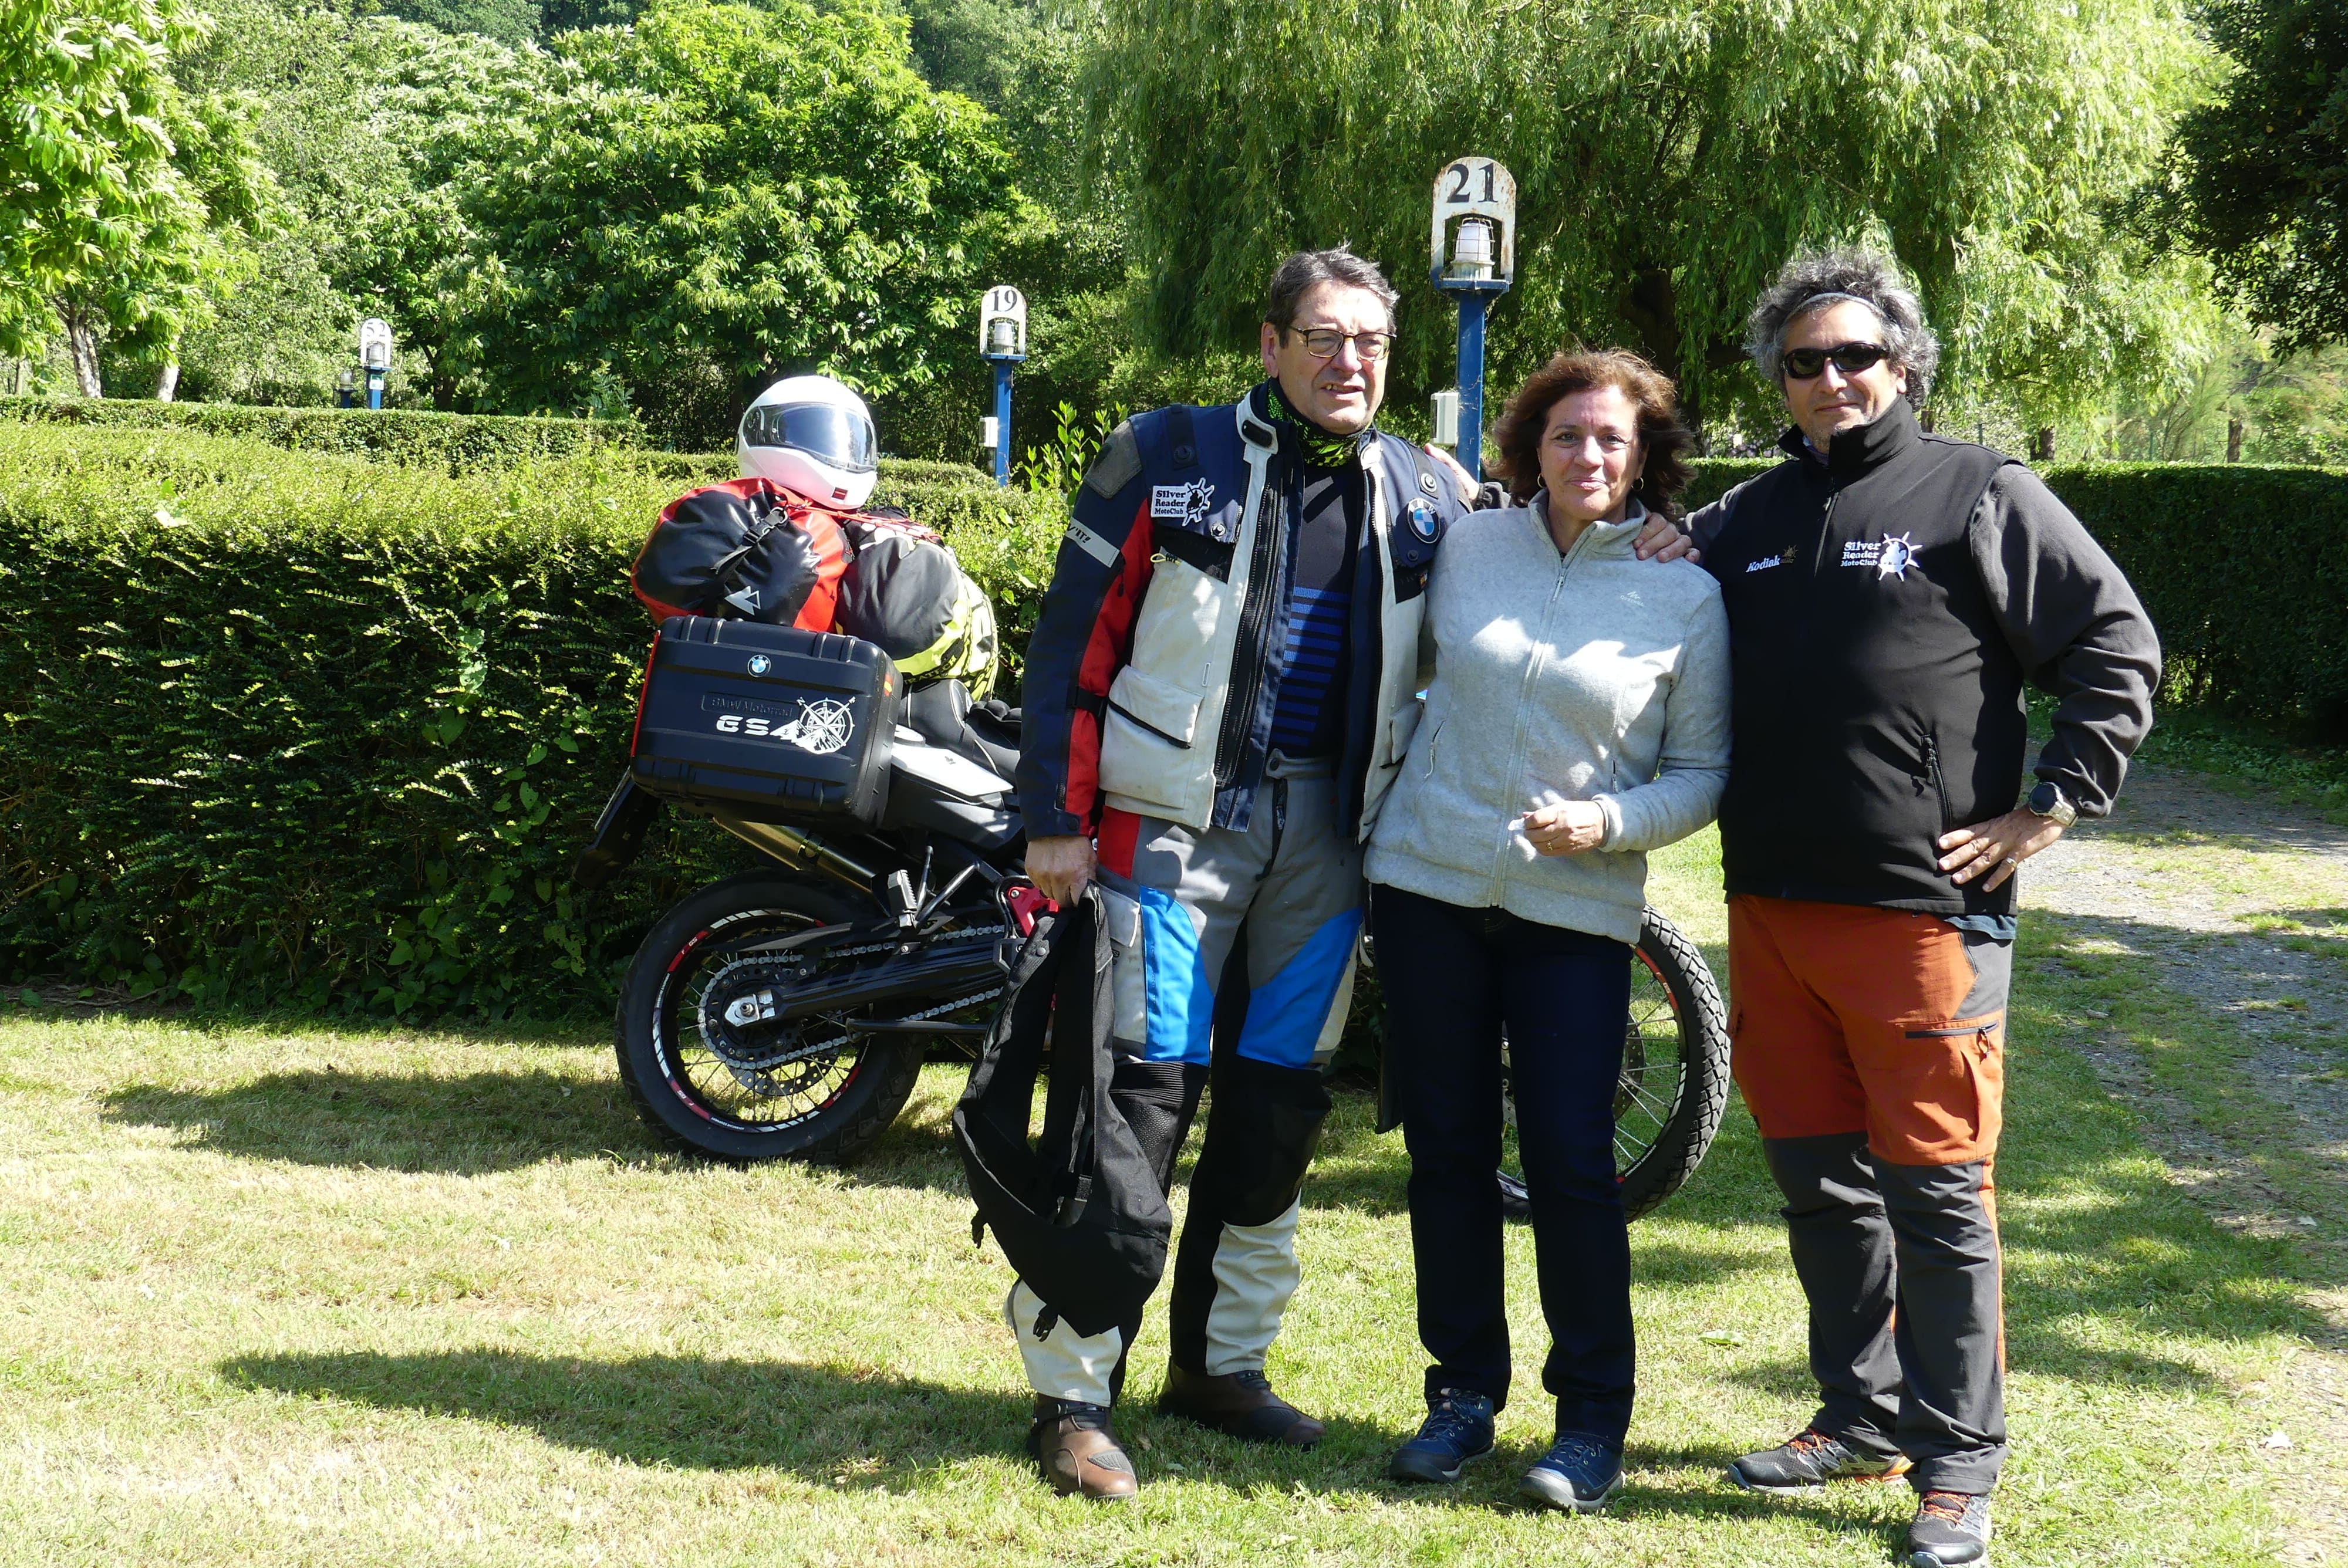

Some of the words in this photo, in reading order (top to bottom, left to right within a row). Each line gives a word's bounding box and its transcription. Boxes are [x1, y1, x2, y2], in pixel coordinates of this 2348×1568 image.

[1446, 162, 1499, 204] 21
[990, 289, 1018, 312] 19
[366, 322, 386, 337] 52
[1841, 550, 1880, 559] Reader
[1844, 541, 1882, 551] Silver
[1745, 555, 1781, 573] Kodiak
[716, 714, 771, 736] GS
